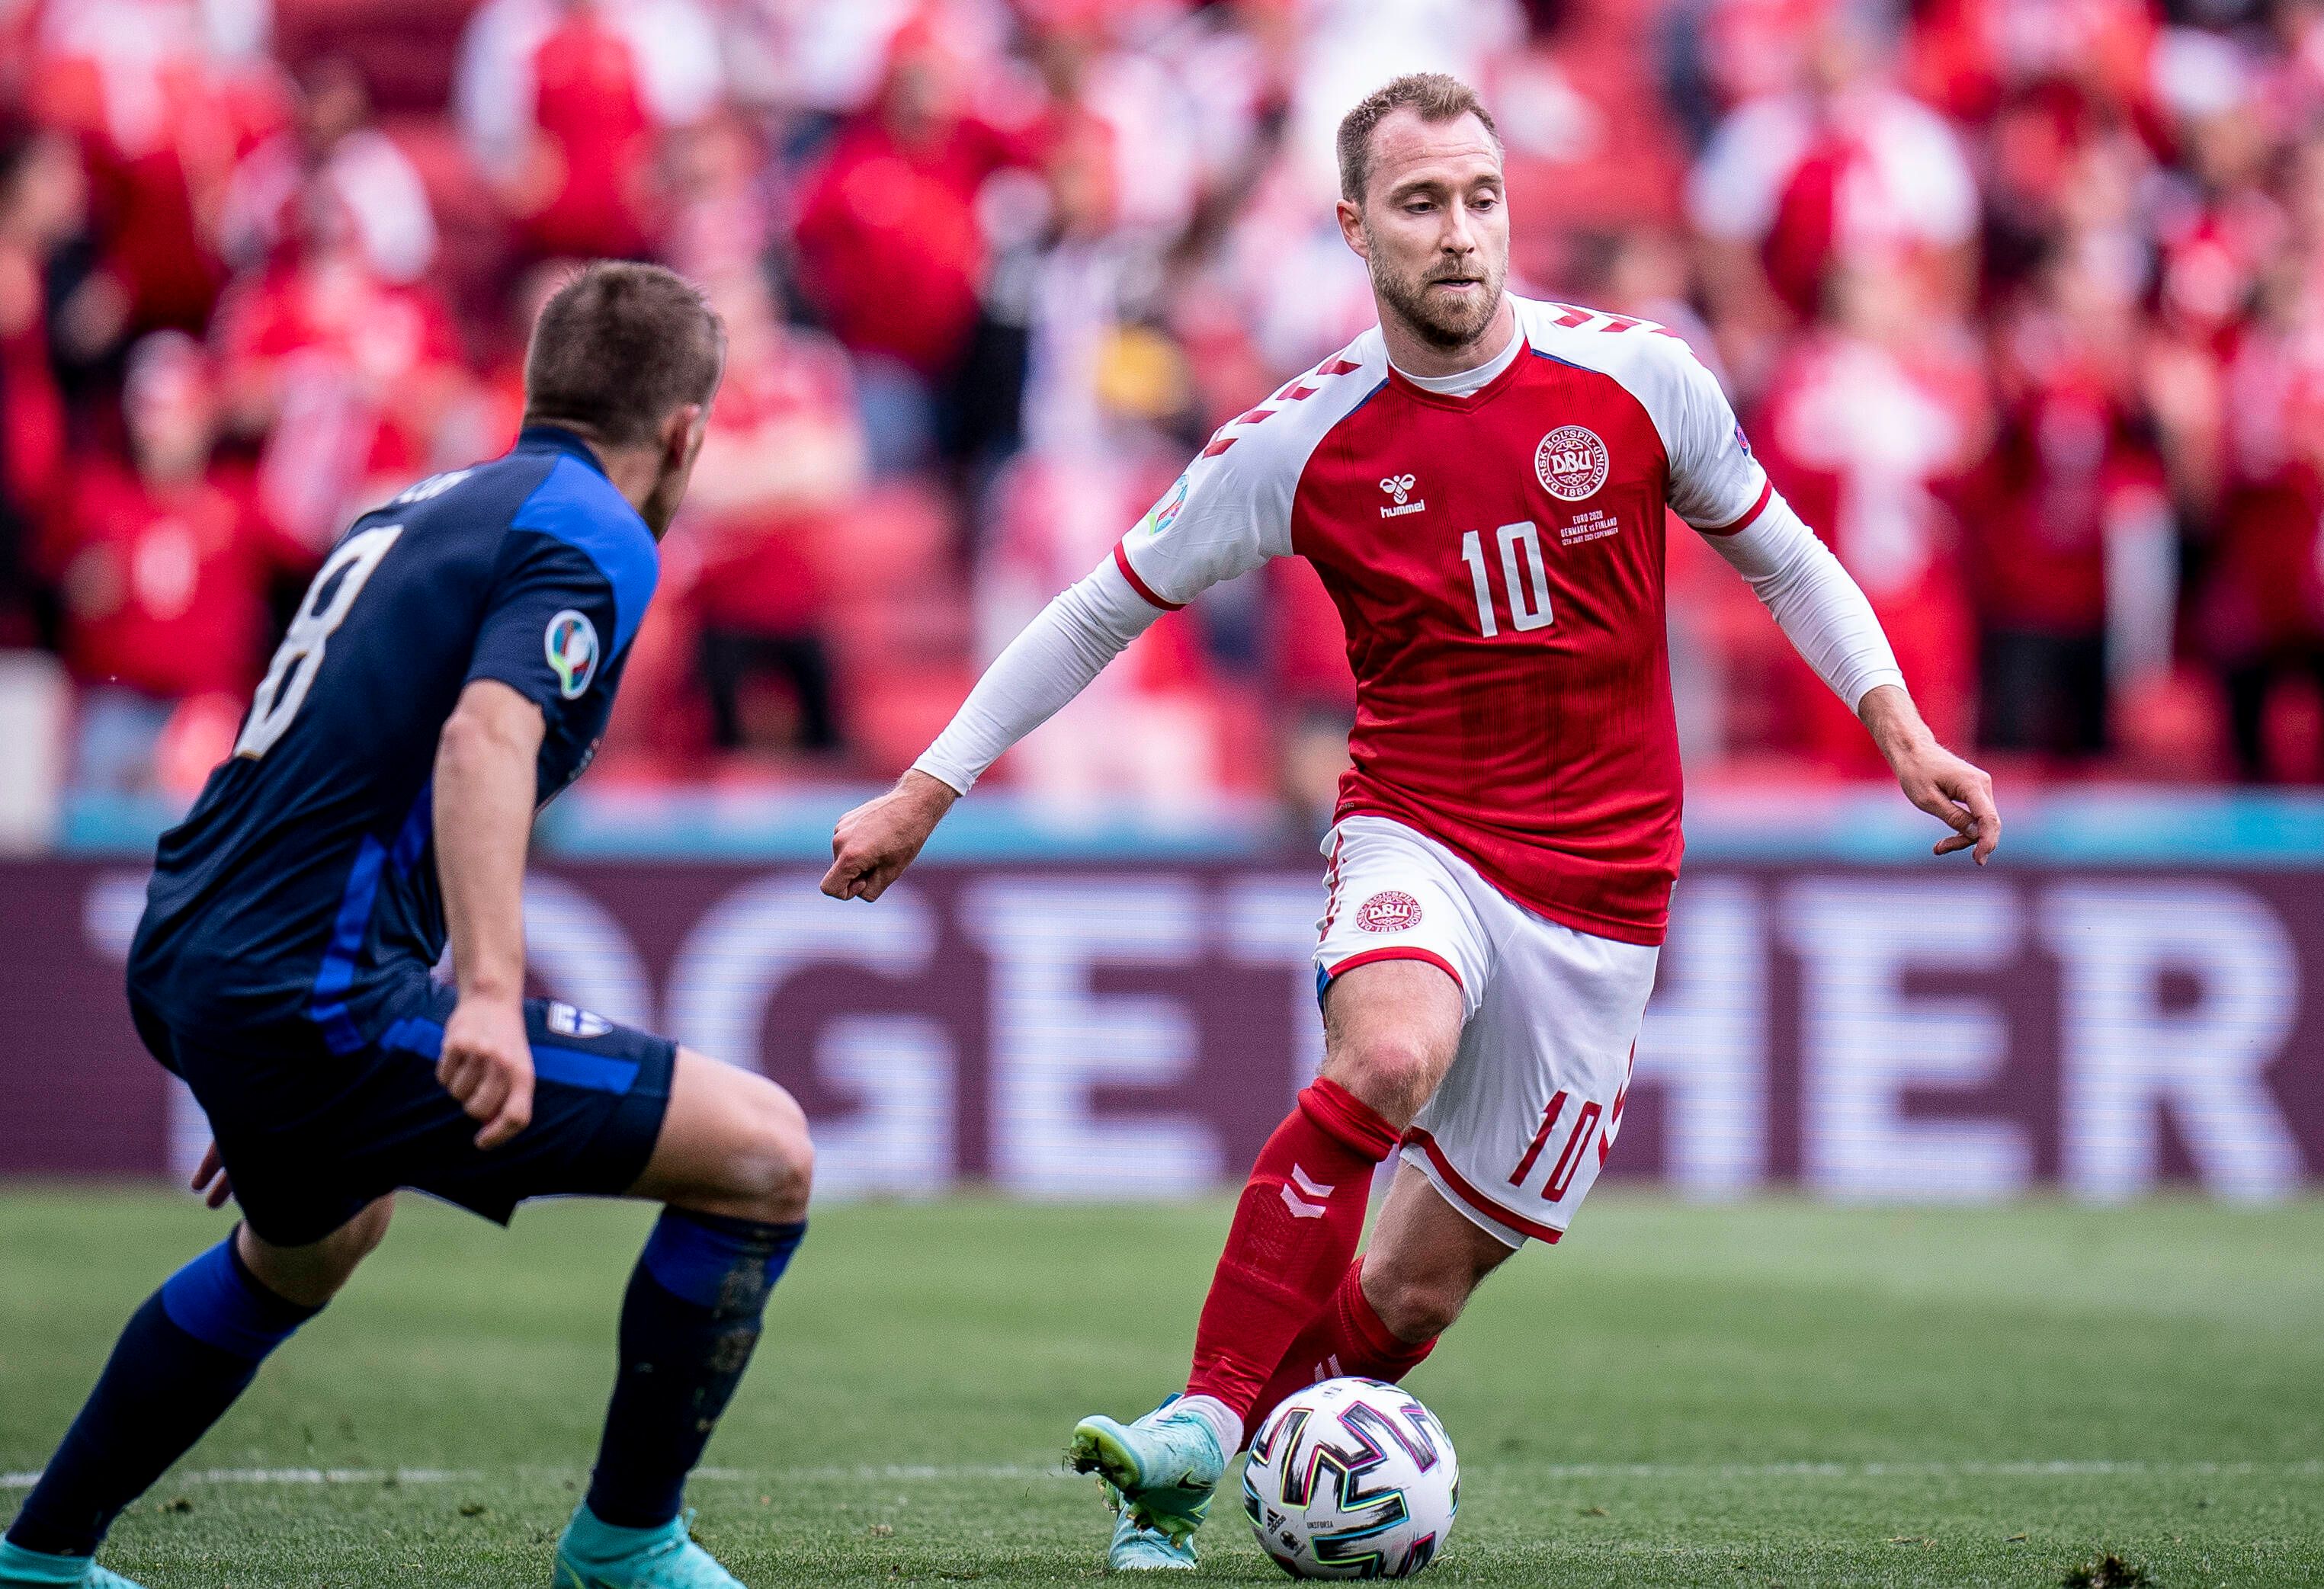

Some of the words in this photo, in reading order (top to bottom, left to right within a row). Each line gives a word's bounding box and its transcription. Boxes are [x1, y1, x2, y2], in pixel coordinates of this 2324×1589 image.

[1550, 450, 1593, 475] DBU
[1563, 485, 1591, 497] 1889
[1380, 499, 1425, 518] hummel
[1572, 513, 1588, 524] EURO
[1588, 510, 1603, 521] 2020
[1560, 524, 1588, 538] DENMARK
[1595, 517, 1617, 530] FINLAND
[1462, 521, 1553, 638] 10
[234, 524, 404, 761] 8
[1368, 903, 1409, 920] DBU
[1508, 1090, 1602, 1203] 10
